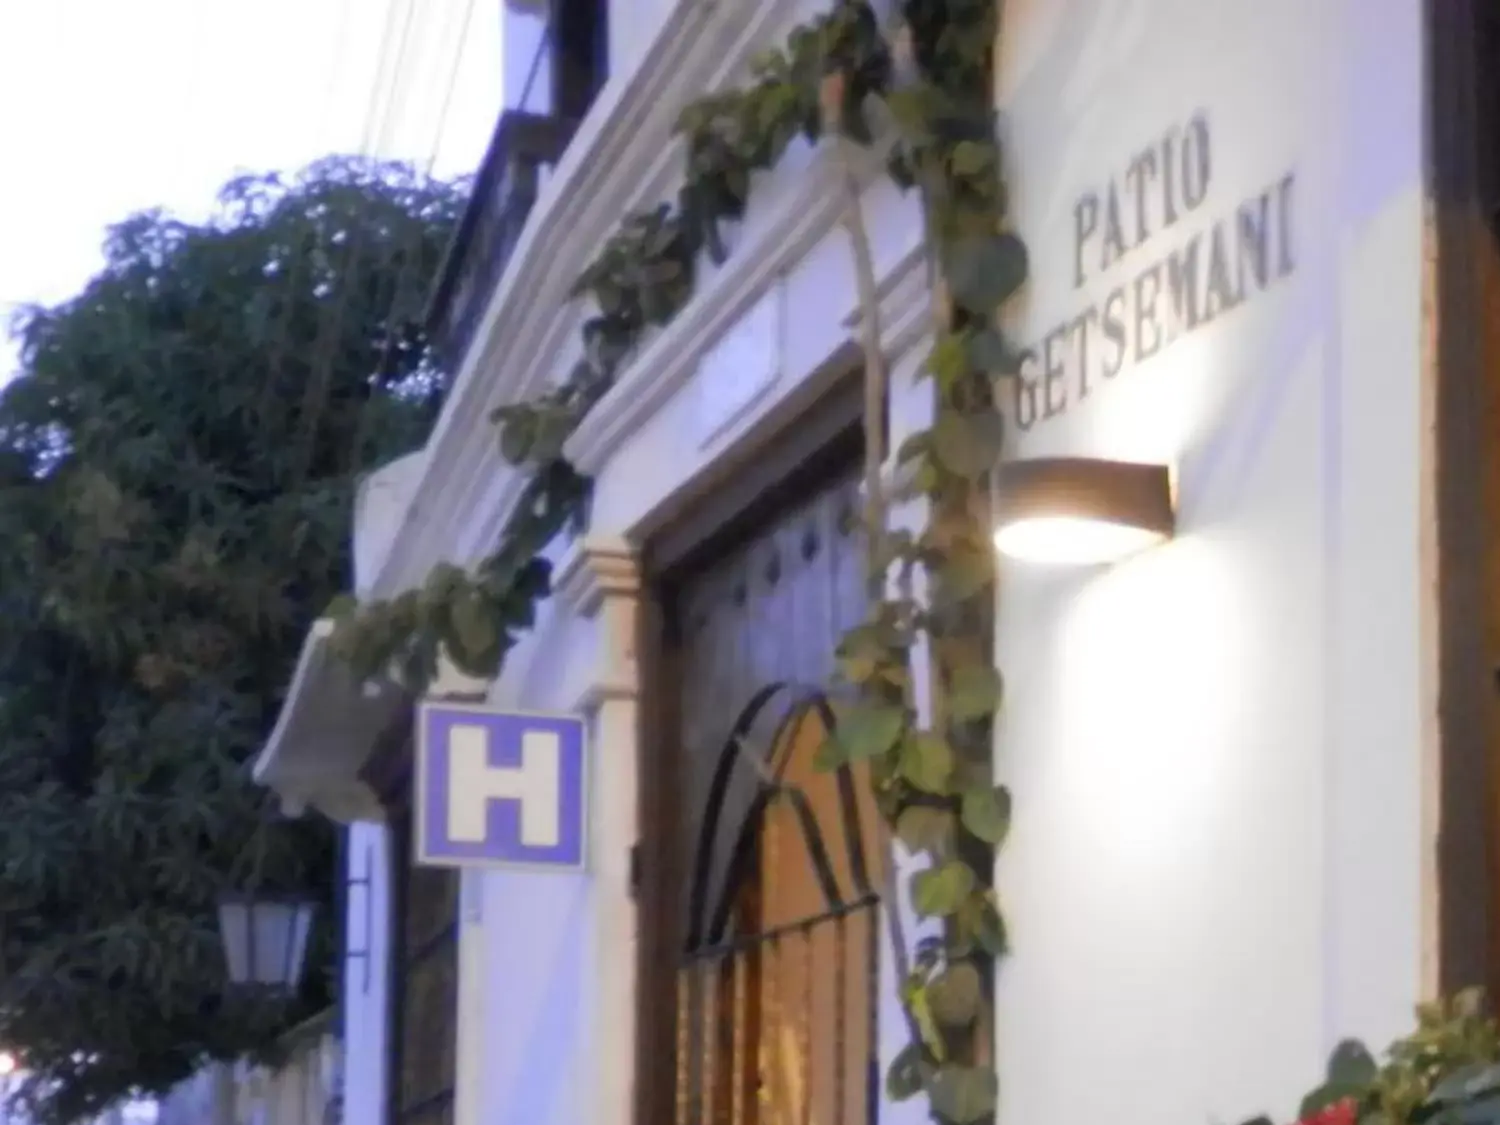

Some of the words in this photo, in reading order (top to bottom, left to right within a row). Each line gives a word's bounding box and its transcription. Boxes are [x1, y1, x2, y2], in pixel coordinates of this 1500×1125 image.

[1073, 109, 1212, 288] PATIO
[1013, 169, 1296, 431] GETSEMANI
[447, 723, 560, 847] H
